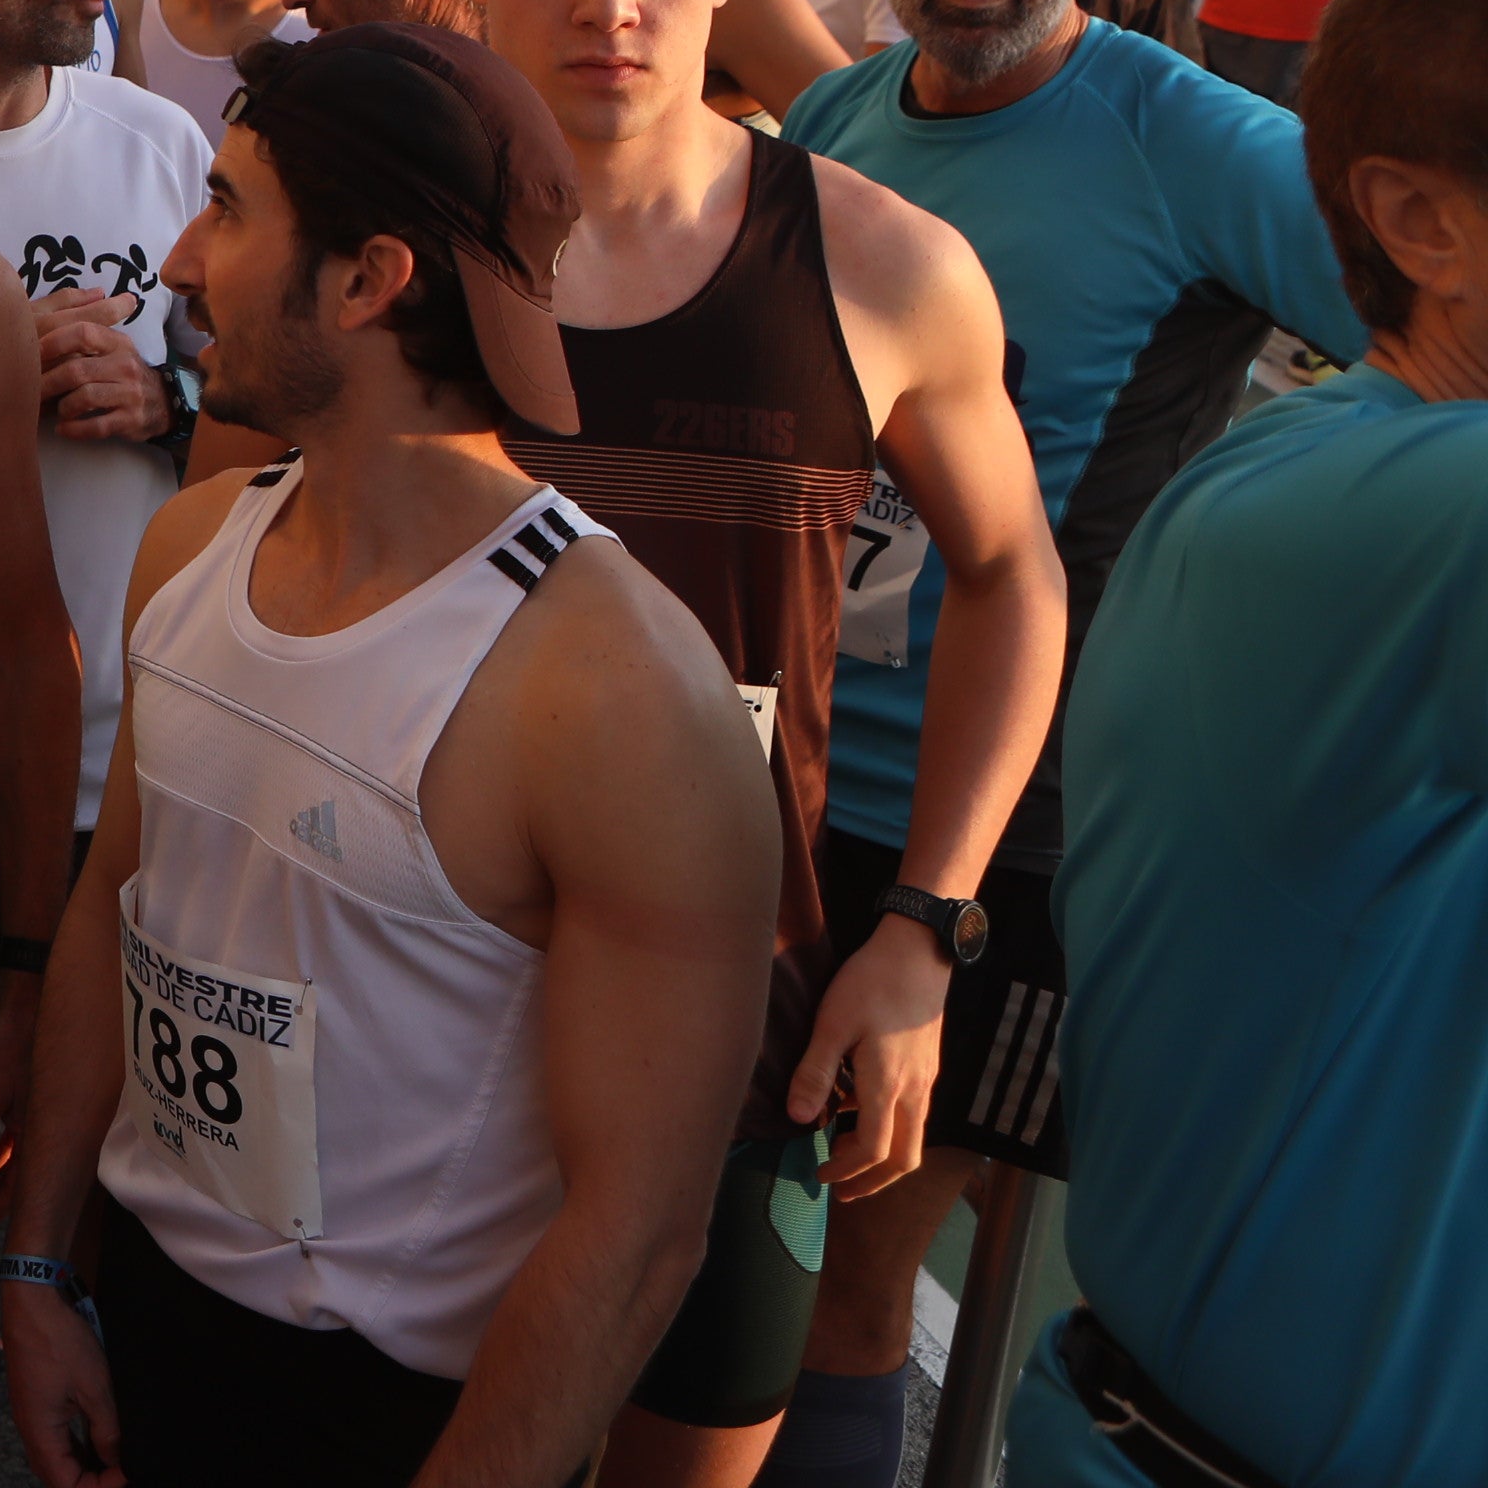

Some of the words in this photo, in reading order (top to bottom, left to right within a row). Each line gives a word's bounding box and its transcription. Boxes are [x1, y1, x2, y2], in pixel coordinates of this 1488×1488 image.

[846, 523, 893, 592] 7
[289, 819, 343, 864] adidas
[128, 929, 293, 1019] SILVESTRE
[156, 973, 187, 1013] DE
[193, 996, 292, 1049] CÁDIZ
[125, 971, 243, 1125] 788
[133, 1061, 241, 1152] RUIZ-HERRERA
